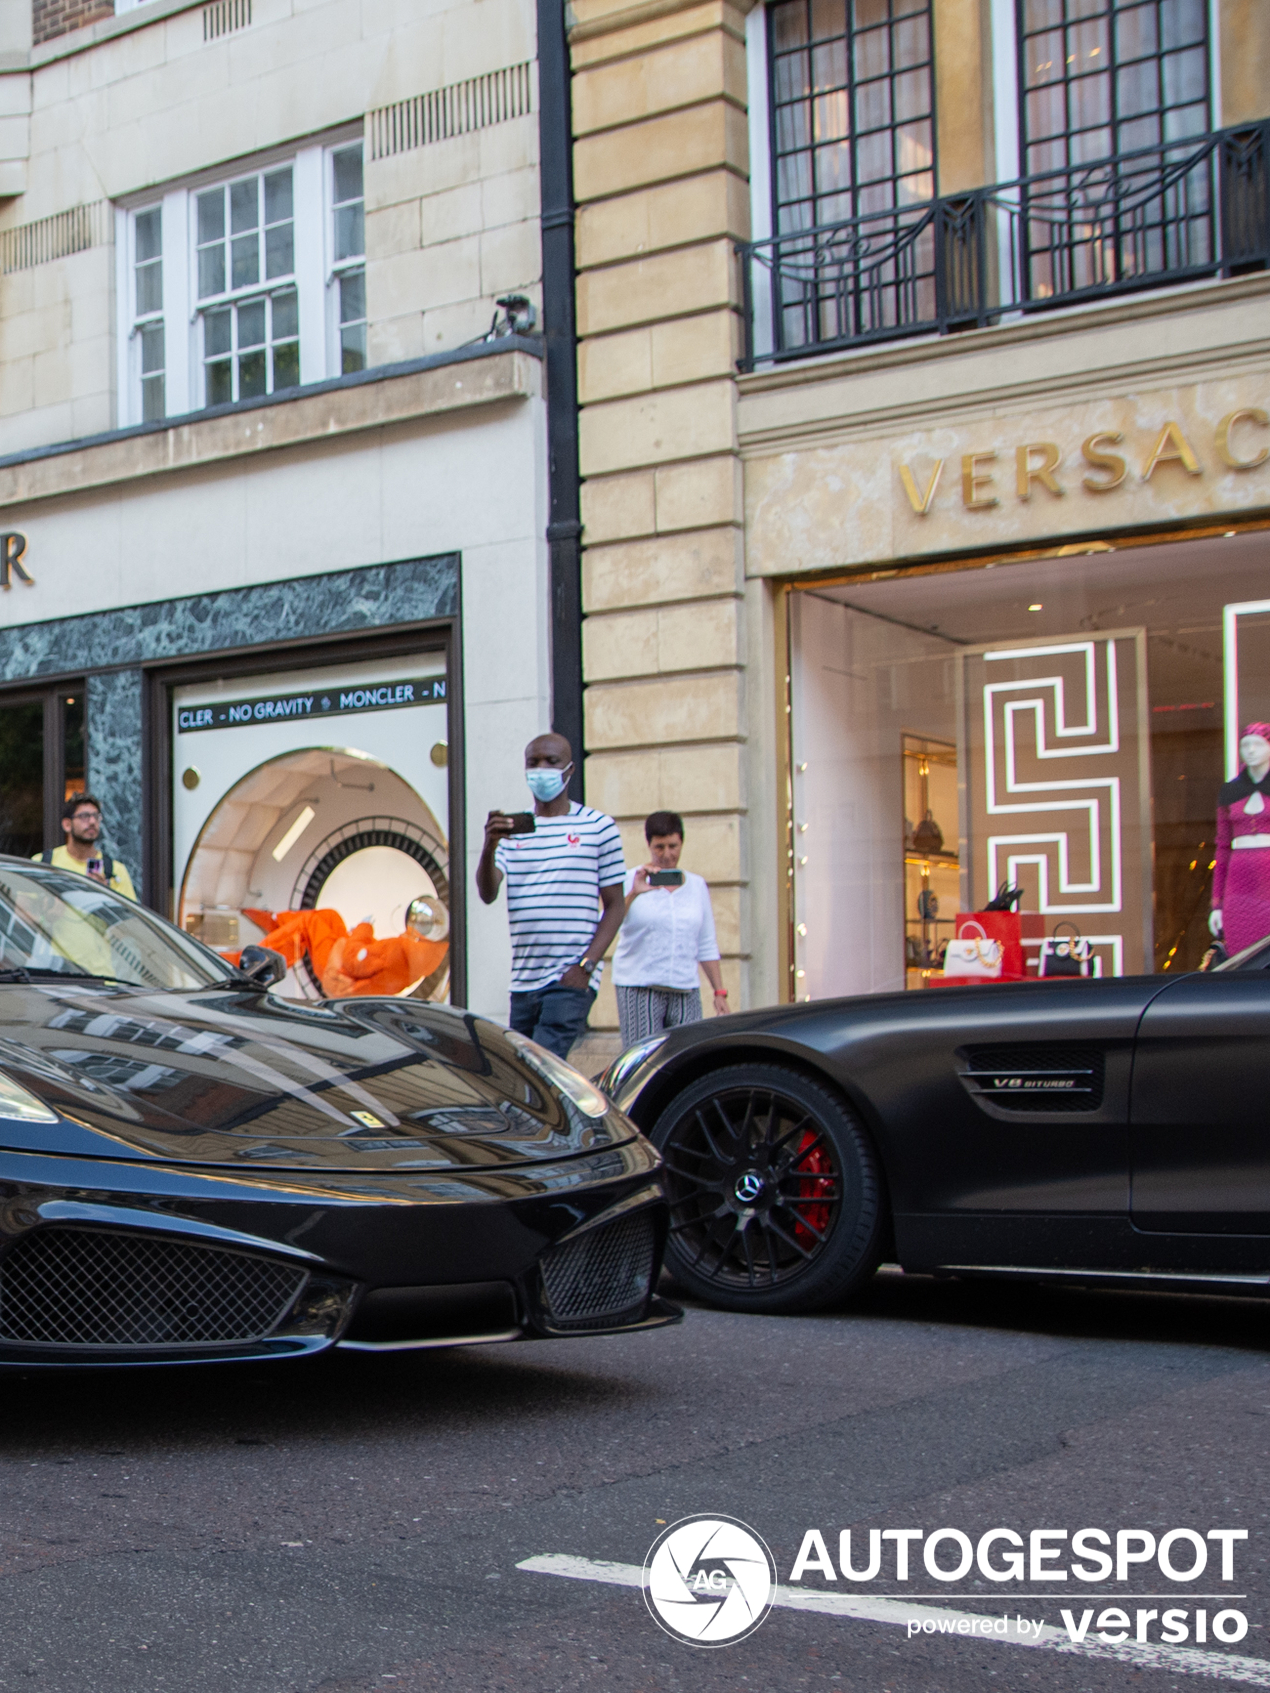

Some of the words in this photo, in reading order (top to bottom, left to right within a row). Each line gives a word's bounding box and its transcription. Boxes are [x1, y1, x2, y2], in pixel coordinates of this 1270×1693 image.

[180, 709, 213, 729] CLER
[229, 705, 252, 723] NO
[253, 696, 314, 720] GRAVITY
[339, 684, 415, 710] MONCLER
[993, 1078, 1022, 1088] V8
[1024, 1080, 1075, 1088] BITURBO
